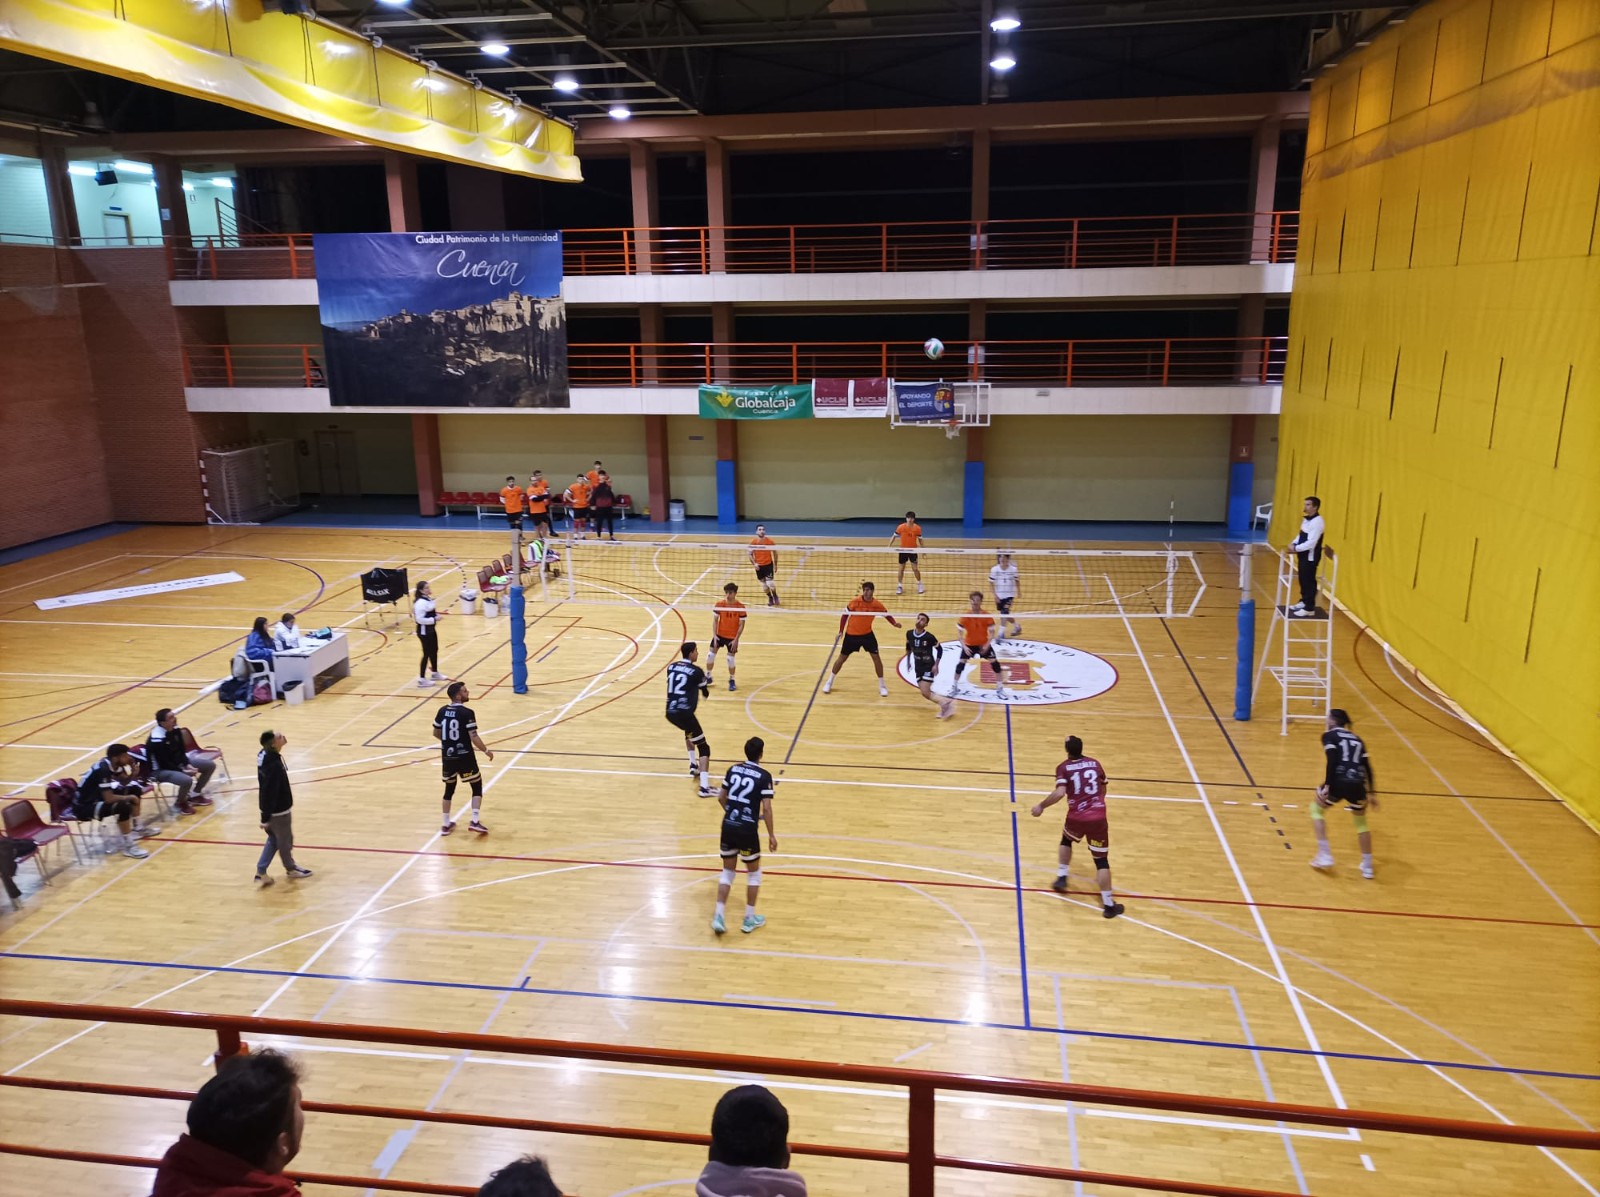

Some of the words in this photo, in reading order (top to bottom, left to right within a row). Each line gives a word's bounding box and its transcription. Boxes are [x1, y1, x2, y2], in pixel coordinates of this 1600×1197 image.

[415, 234, 444, 244] Ciudad
[446, 234, 488, 244] Patrimonio
[489, 233, 500, 243] de
[502, 233, 510, 242] la
[512, 232, 558, 242] Humanidad
[436, 249, 525, 287] Cuenca
[735, 396, 796, 411] Globalcaja
[900, 392, 931, 400] APOYANDO
[668, 671, 688, 695] 12
[441, 718, 460, 741] 18
[1338, 738, 1362, 764] 17
[727, 773, 755, 804] 22
[1070, 769, 1098, 795] 13
